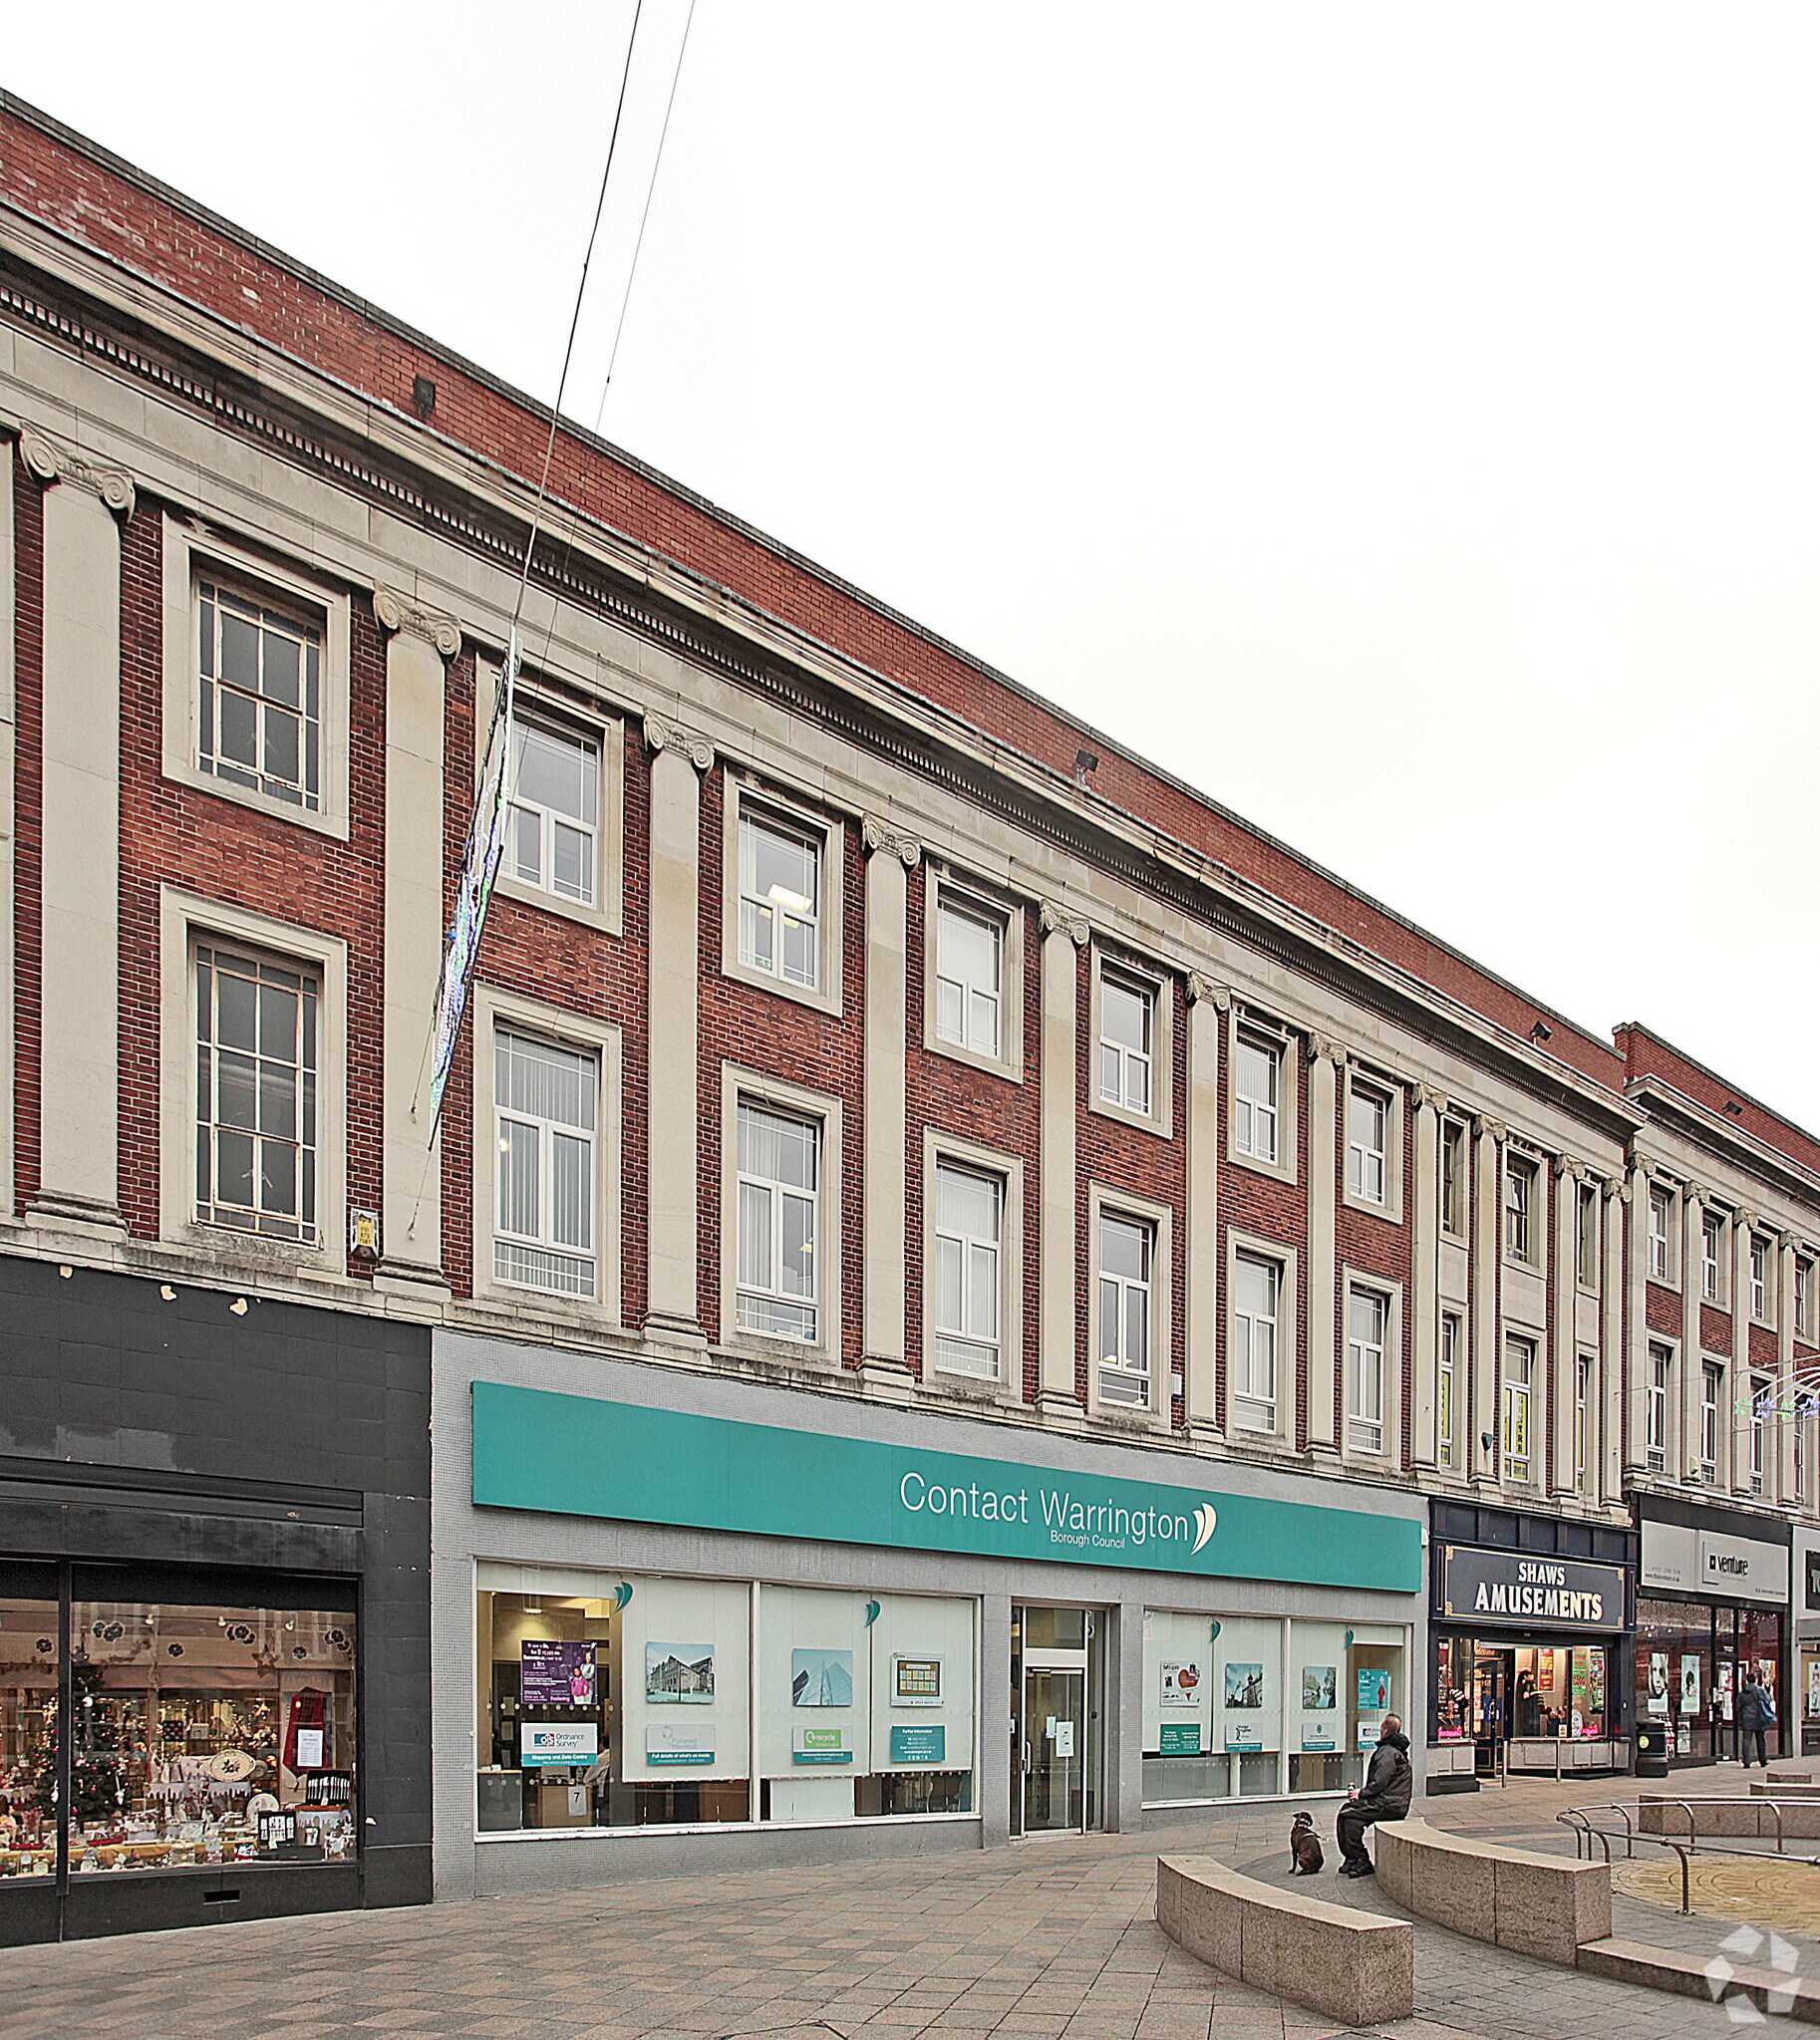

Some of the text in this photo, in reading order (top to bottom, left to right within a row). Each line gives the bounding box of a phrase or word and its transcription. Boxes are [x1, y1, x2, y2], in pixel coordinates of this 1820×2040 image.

[900, 1472, 1189, 1545] Contact Warrington
[1051, 1530, 1125, 1549] Borough Council
[1518, 1562, 1566, 1587] SHAWS
[1717, 1556, 1748, 1575] venture
[1474, 1582, 1604, 1620] AMUSEMENTS
[816, 1733, 835, 1742] recycle
[574, 1792, 580, 1803] 7
